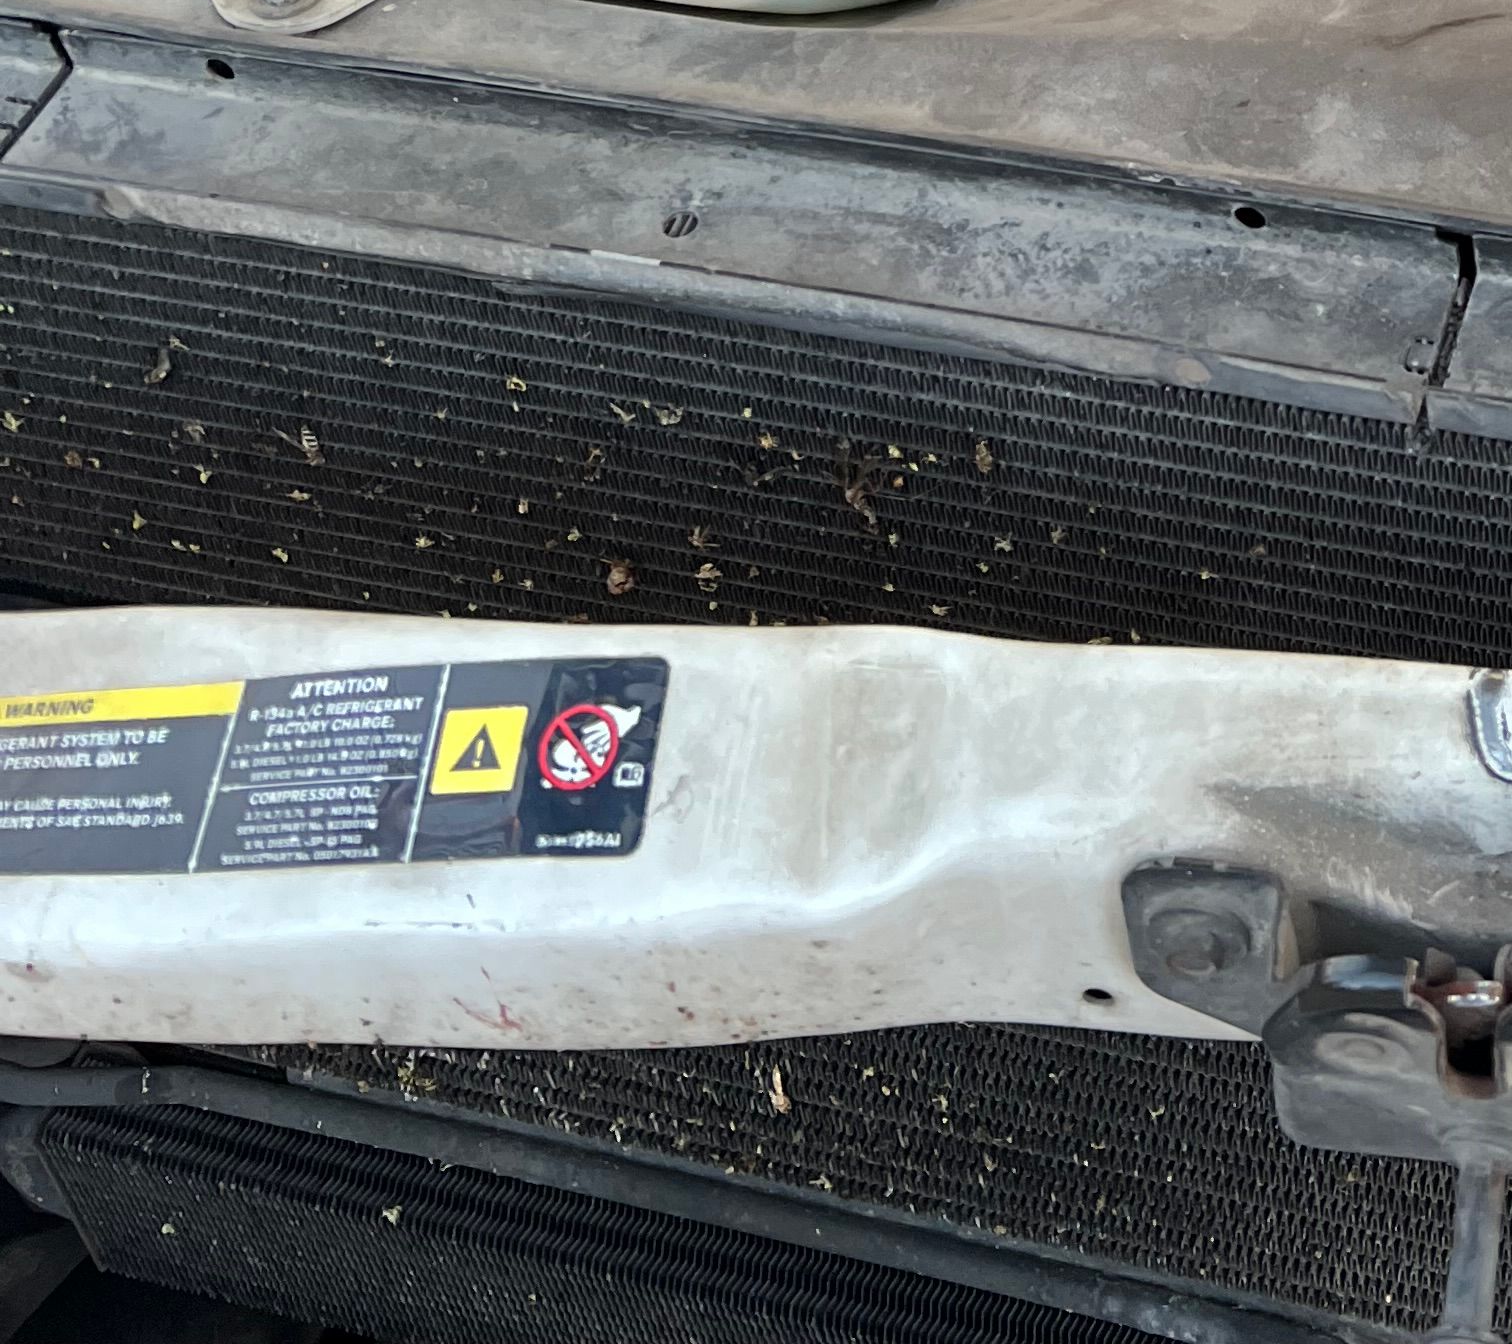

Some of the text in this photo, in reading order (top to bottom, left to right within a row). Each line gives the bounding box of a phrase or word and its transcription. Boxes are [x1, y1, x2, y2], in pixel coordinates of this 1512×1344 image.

[290, 676, 389, 699] ATTENTION
[5, 698, 95, 719] WARNING
[325, 696, 424, 715] REFRIGERANT
[266, 715, 396, 737] FACTORY CHARGE:
[60, 729, 122, 748] SYSTEM
[123, 728, 145, 745] TO
[147, 727, 170, 744] BE
[3, 753, 92, 771] PERSONNEL
[57, 796, 122, 810] PERSONAL
[249, 786, 346, 805] COMPRESSOR
[36, 816, 55, 828] OF
